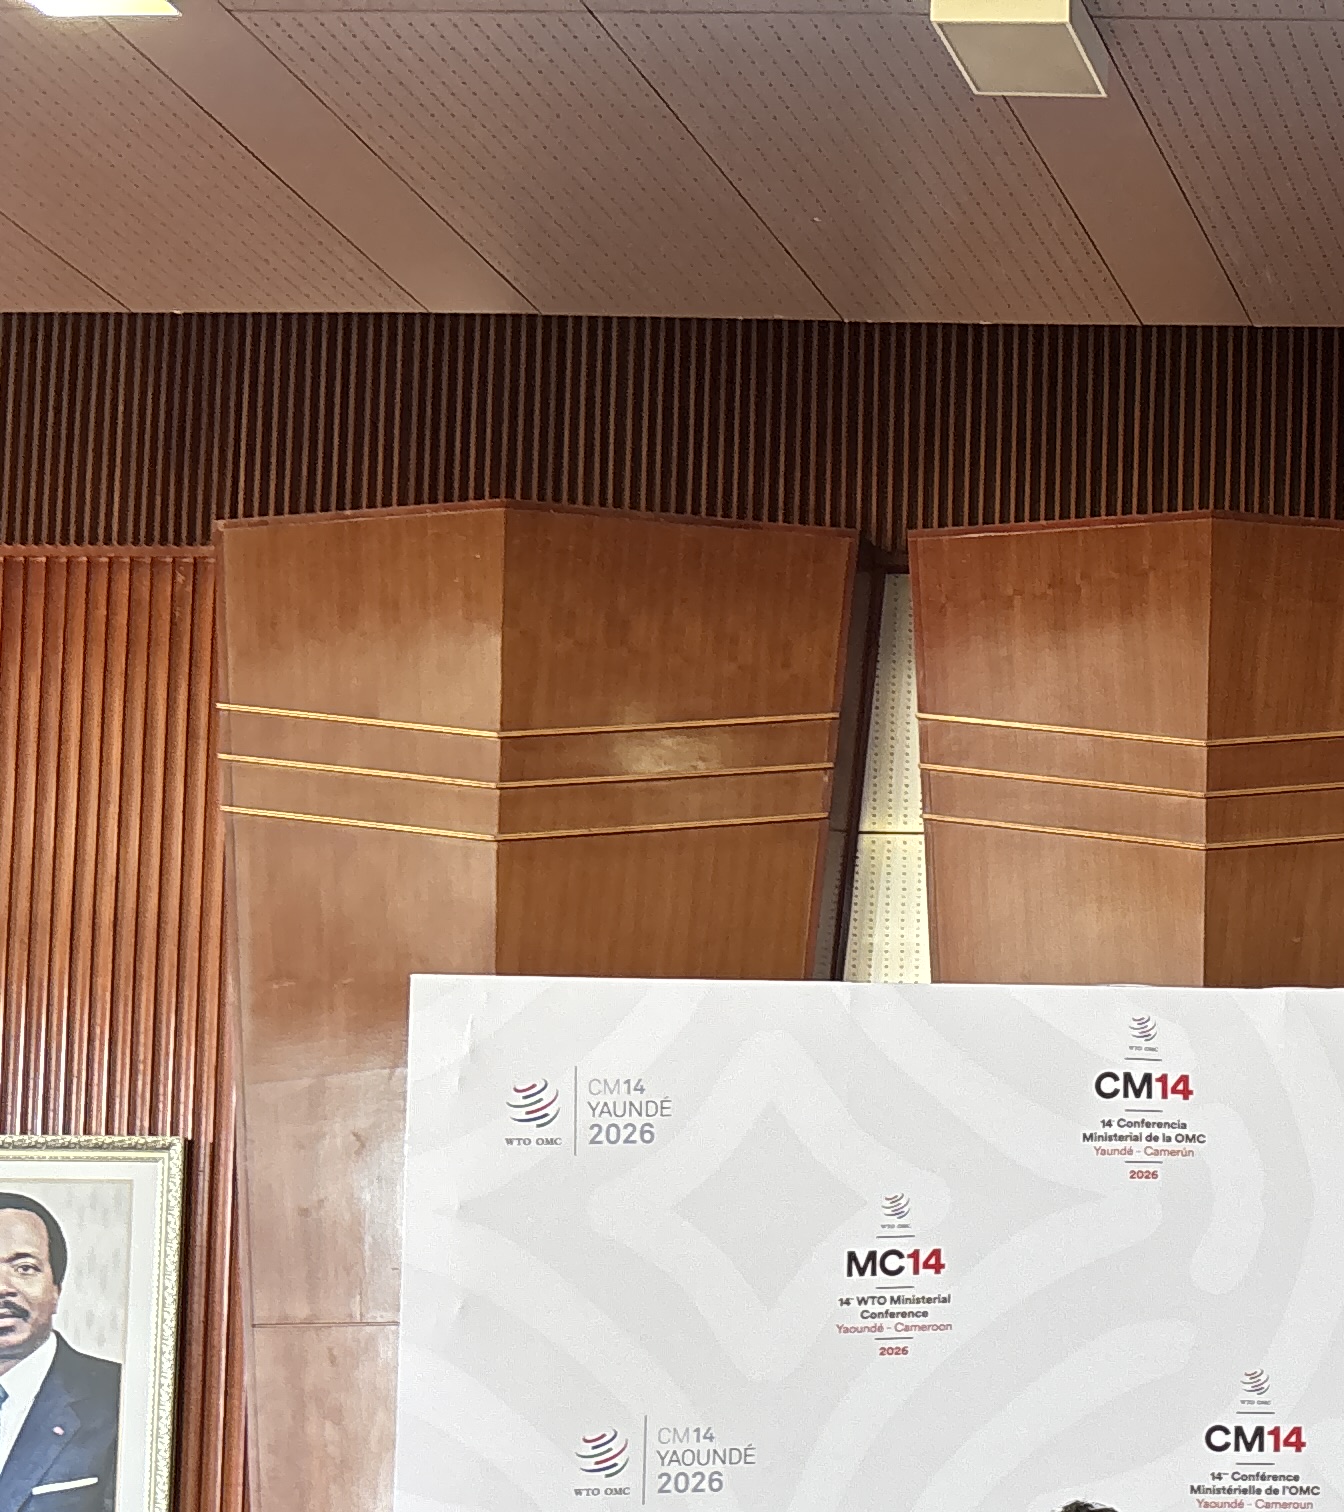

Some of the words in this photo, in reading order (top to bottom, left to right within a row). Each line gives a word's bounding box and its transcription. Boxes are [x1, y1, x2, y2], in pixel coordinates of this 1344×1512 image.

[588, 1078, 645, 1095] CM14
[1095, 1072, 1194, 1100] CM14
[587, 1096, 672, 1118] YAUNDÉ
[1100, 1119, 1115, 1128] 14
[1117, 1118, 1187, 1129] Conferencia
[589, 1123, 655, 1144] 2026
[1083, 1132, 1142, 1142] Ministerial
[1145, 1133, 1159, 1142] de
[1162, 1133, 1172, 1142] la
[1175, 1134, 1206, 1143] OMC
[536, 1137, 562, 1146] OMC
[1094, 1146, 1133, 1156] Yaundé
[1144, 1146, 1194, 1157] Camerún
[1129, 1170, 1158, 1179] 2026
[847, 1249, 945, 1277] MC14
[839, 1297, 854, 1306] 14
[856, 1296, 887, 1305] WTO
[890, 1294, 951, 1304] Ministerial
[860, 1310, 928, 1319] Conference
[836, 1324, 884, 1334] Yaoundé
[895, 1323, 952, 1332] Cameroon
[879, 1347, 908, 1355] 2026
[658, 1427, 714, 1444] CM14
[1205, 1425, 1306, 1452] CM14
[657, 1444, 756, 1466] YAOUNDÉ
[657, 1471, 723, 1493] 2026
[1231, 1472, 1300, 1481] Conférence
[574, 1488, 600, 1496] WTO
[604, 1487, 630, 1495] OMC
[1190, 1485, 1262, 1495] Ministérielle
[1265, 1486, 1279, 1495] de
[1196, 1499, 1244, 1508] Yaoundé
[1255, 1500, 1313, 1509] Cameroun
